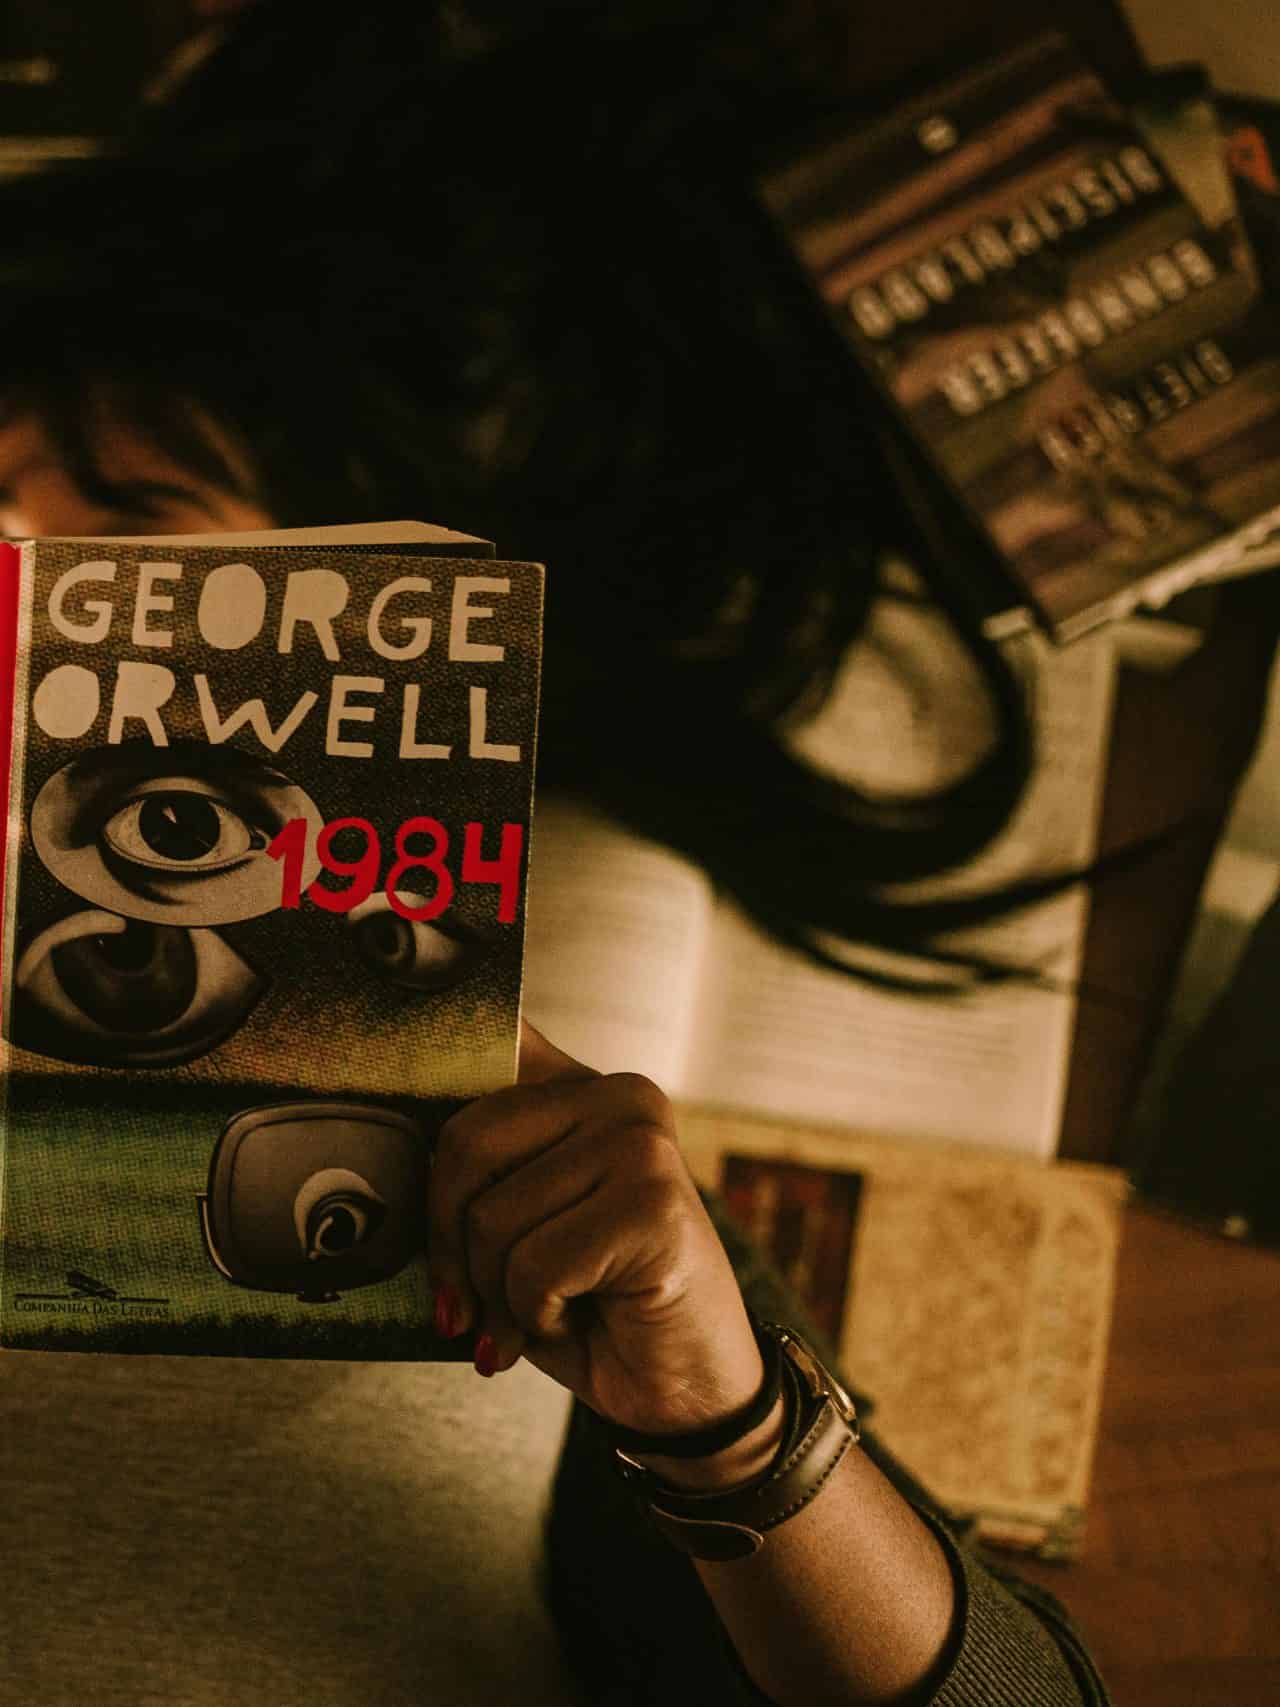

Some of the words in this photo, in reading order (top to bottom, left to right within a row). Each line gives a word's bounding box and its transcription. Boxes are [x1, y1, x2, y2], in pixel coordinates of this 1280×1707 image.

[48, 561, 511, 662] GEORGE
[33, 661, 521, 762] ORWELL
[265, 816, 523, 924] 1984
